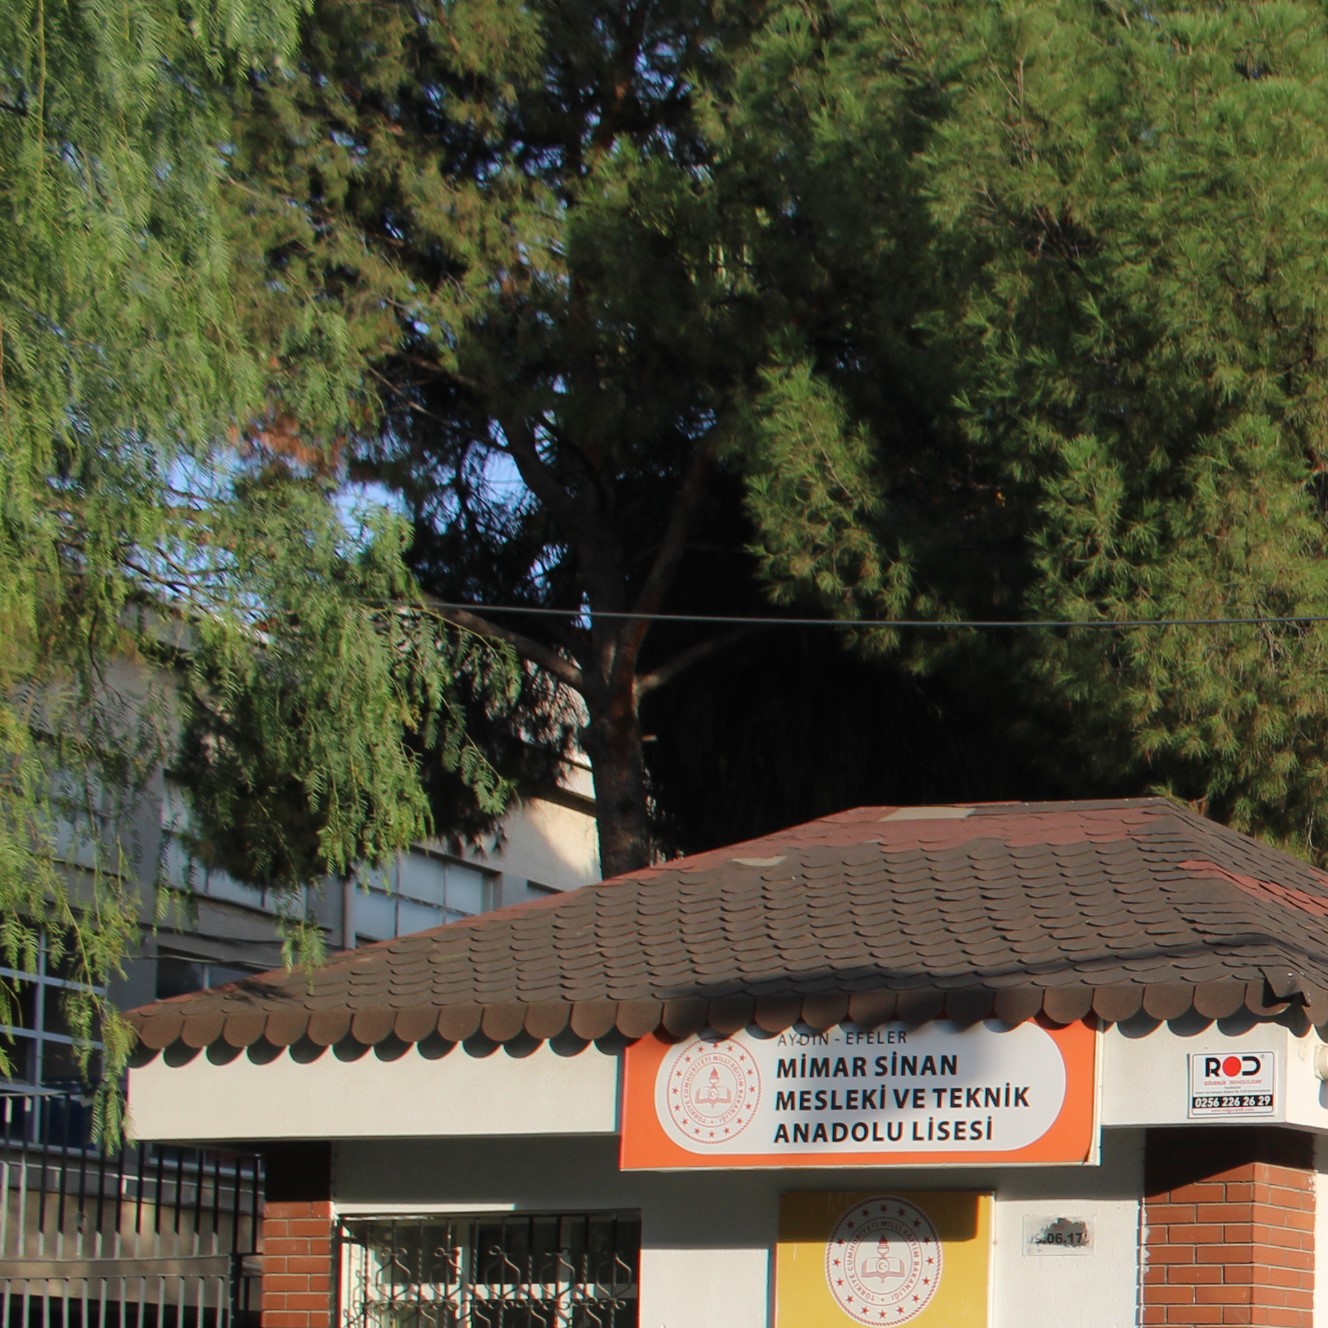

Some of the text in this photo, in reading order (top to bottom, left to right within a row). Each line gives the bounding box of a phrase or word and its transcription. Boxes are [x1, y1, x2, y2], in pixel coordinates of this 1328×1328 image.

[846, 1030, 908, 1045] EFELER
[777, 1051, 958, 1078] MİMAR SİNAN
[776, 1082, 1030, 1111] MESLEKİ VE TEKNİK
[1195, 1096, 1270, 1108] 0256 226 26 29
[774, 1116, 993, 1143] ANADOLU LİSESİ
